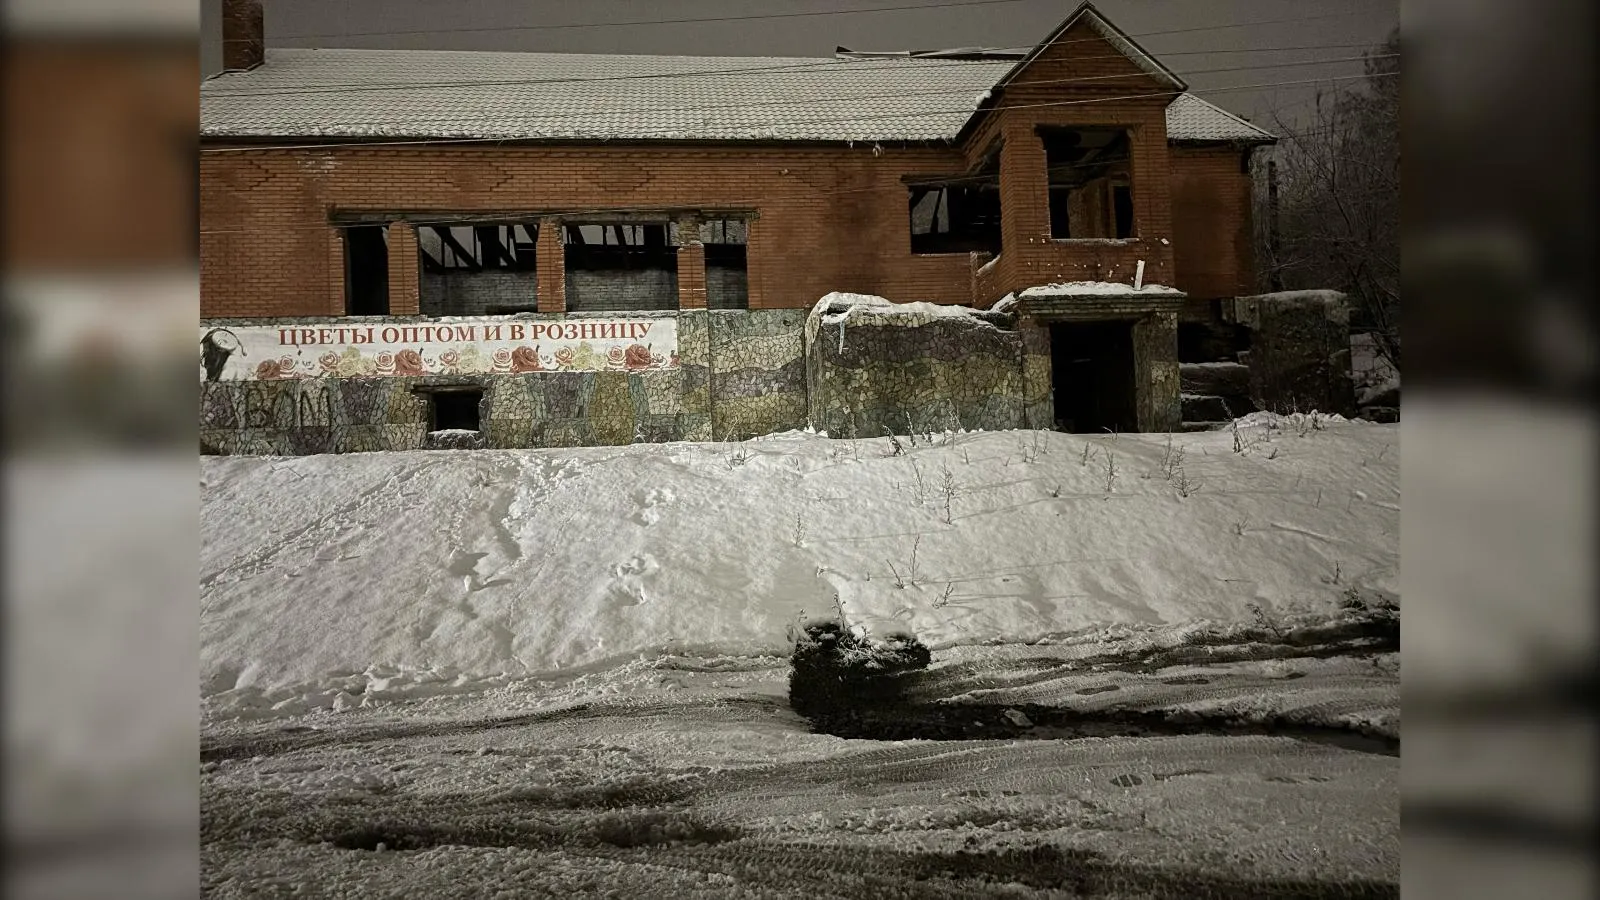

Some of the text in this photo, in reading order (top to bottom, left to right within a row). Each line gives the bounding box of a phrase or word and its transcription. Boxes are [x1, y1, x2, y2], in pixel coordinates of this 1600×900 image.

[278, 322, 653, 348] ЦВЕТЫ ОПТОМ И В РОЗНИЦУ
